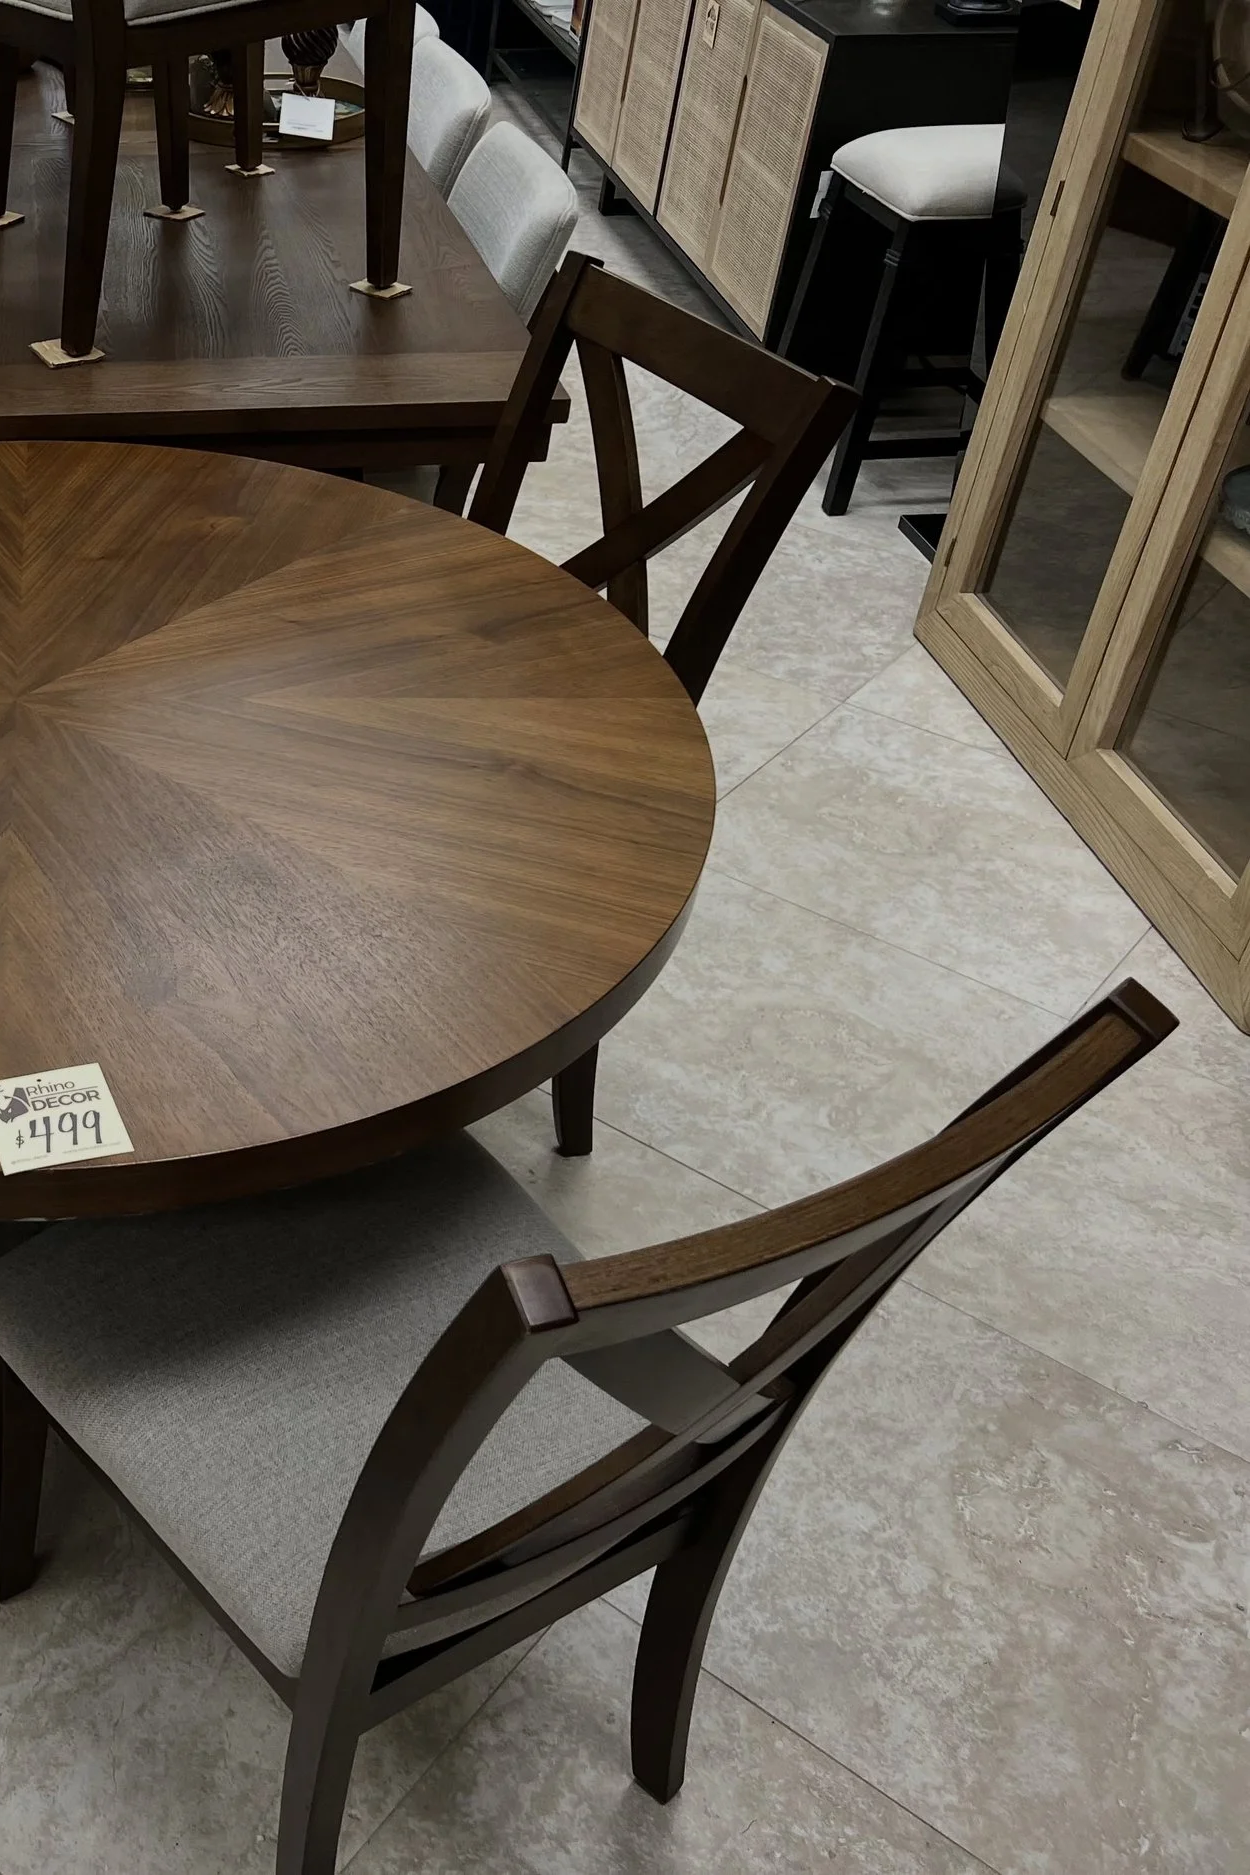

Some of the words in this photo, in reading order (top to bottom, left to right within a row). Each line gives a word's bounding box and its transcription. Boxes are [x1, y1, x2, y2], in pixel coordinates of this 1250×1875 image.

[26, 1081, 75, 1096] Rhino
[31, 1089, 101, 1112] DECOR
[15, 1110, 102, 1153] $499
